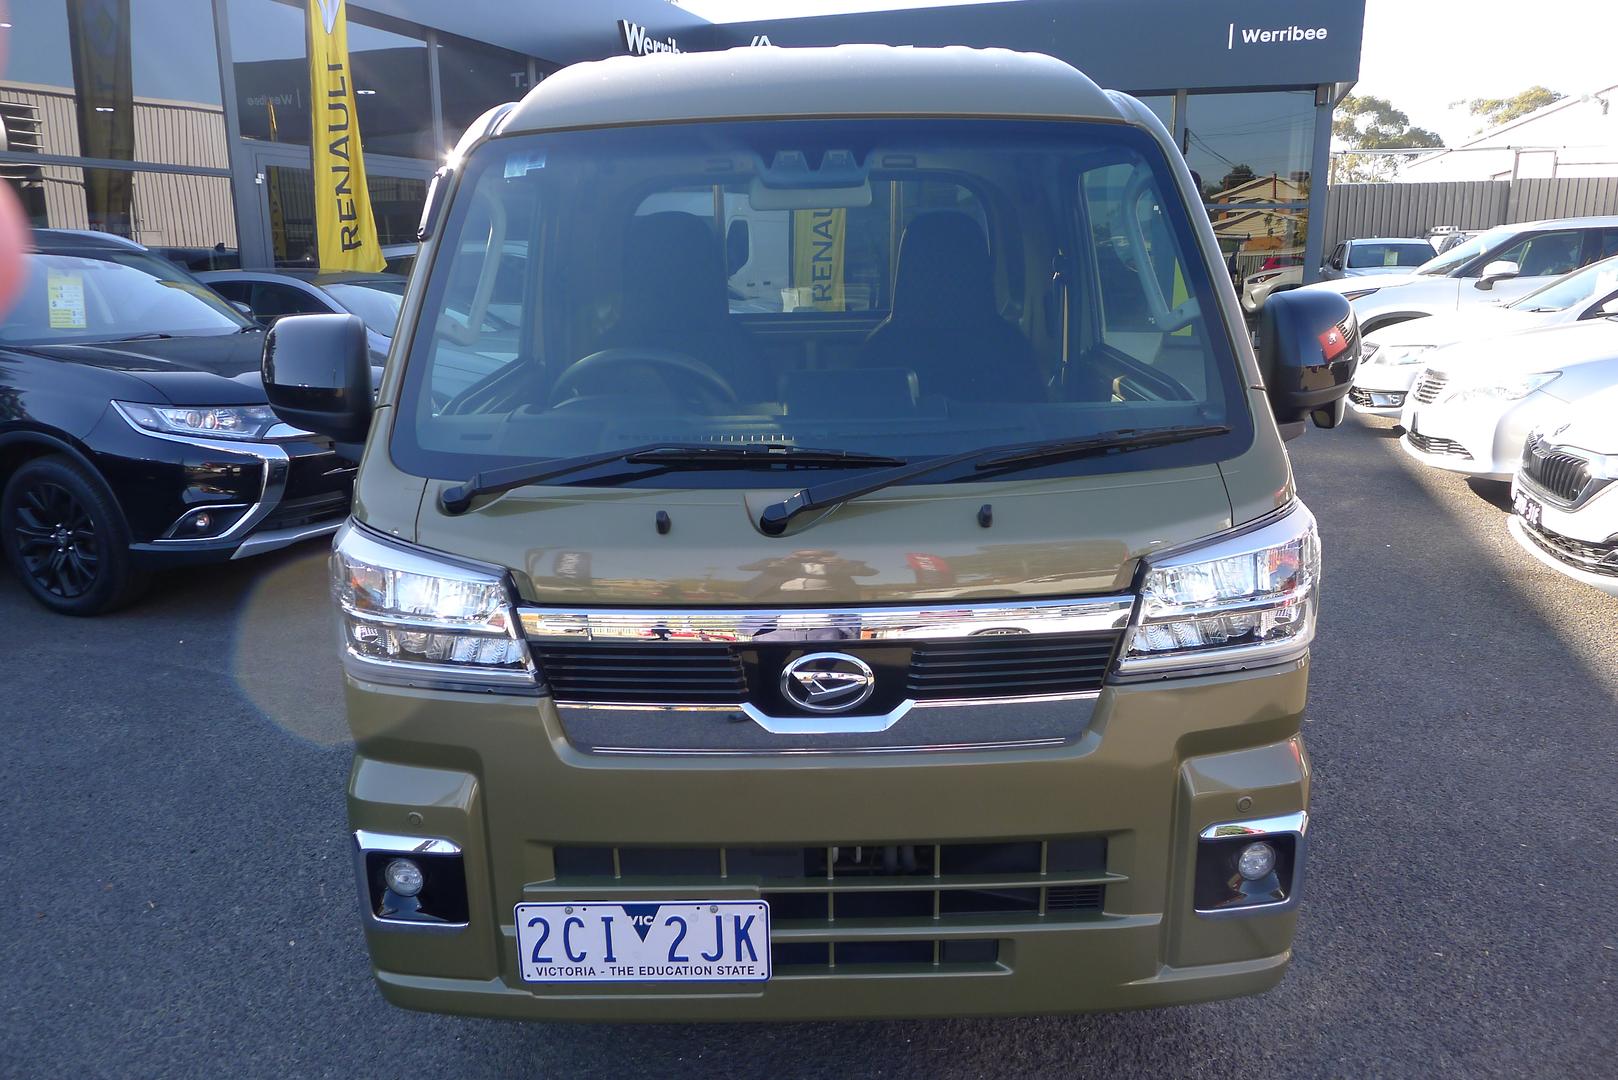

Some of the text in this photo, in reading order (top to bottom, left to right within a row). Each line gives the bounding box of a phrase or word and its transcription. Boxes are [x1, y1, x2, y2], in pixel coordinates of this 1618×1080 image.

[621, 18, 687, 55] Werrib
[1242, 26, 1328, 43] Werribee
[326, 52, 363, 254] RENAULT
[627, 914, 655, 926] VIC
[527, 915, 759, 963] 2CI 2JK
[536, 966, 597, 977] VICTORIA
[609, 965, 635, 977] THE
[638, 965, 713, 976] EDUCATION
[716, 965, 756, 976] STATE
